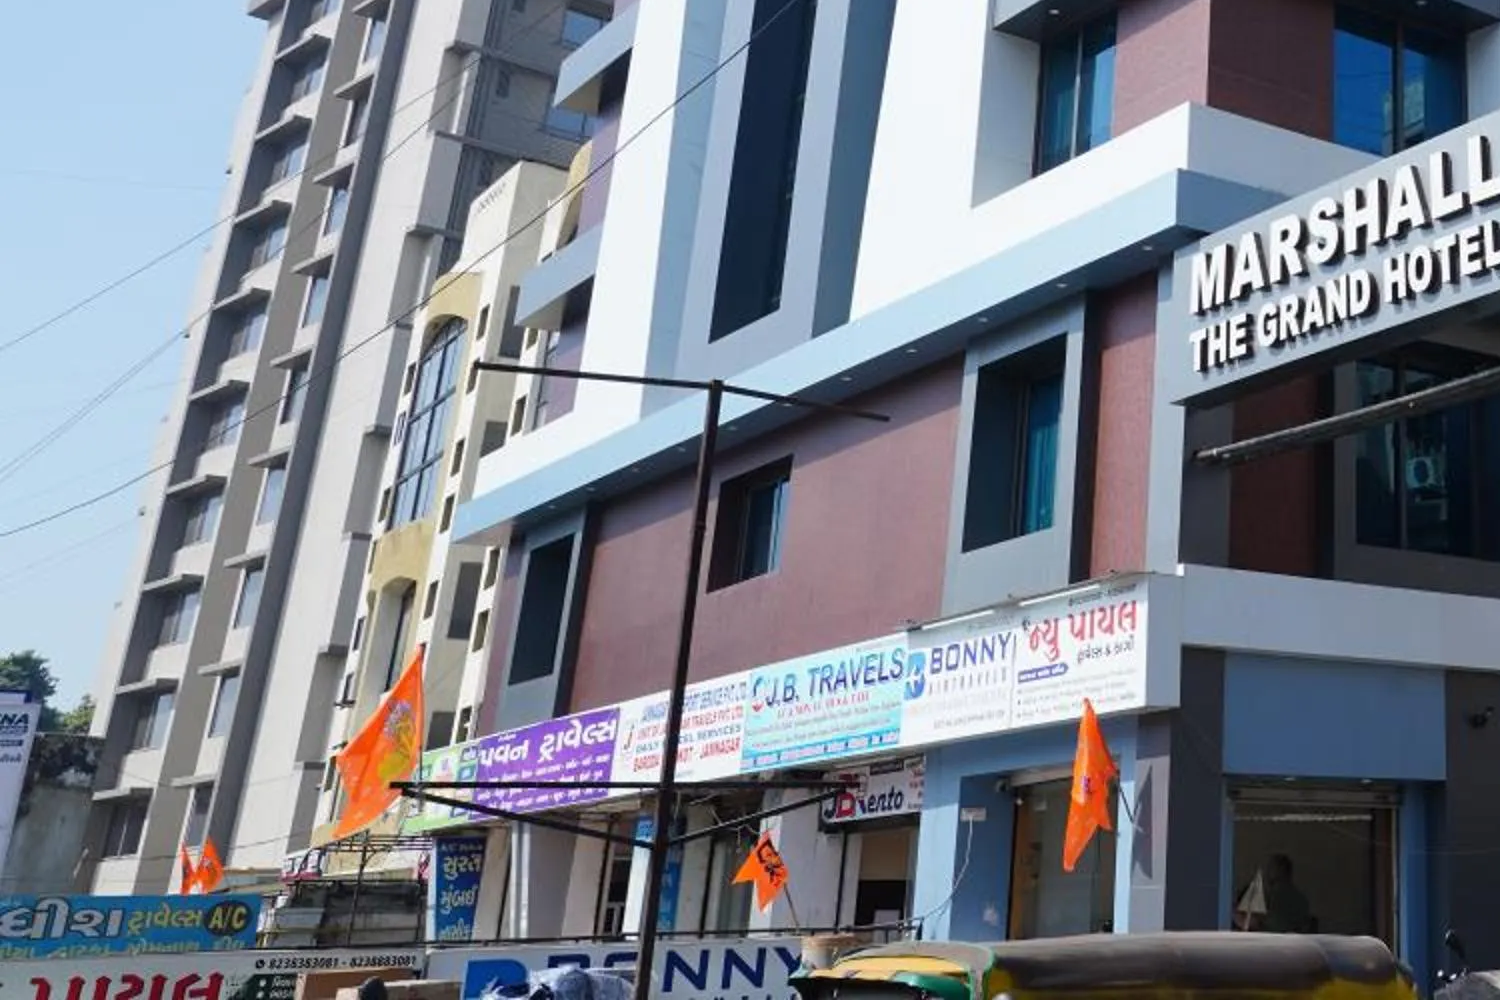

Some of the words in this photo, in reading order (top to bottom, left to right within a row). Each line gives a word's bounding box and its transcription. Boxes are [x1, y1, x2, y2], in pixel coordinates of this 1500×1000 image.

[1189, 313, 1252, 373] THE
[1256, 268, 1376, 349] GRAND
[1068, 600, 1137, 642] પાયલ
[930, 631, 1012, 675] BONNY
[766, 674, 800, 706] J.B.
[808, 648, 905, 697] TRAVELS
[479, 741, 530, 766] પવન
[538, 718, 617, 763] ટ્રાવેલ્સ
[208, 906, 247, 931] A/C
